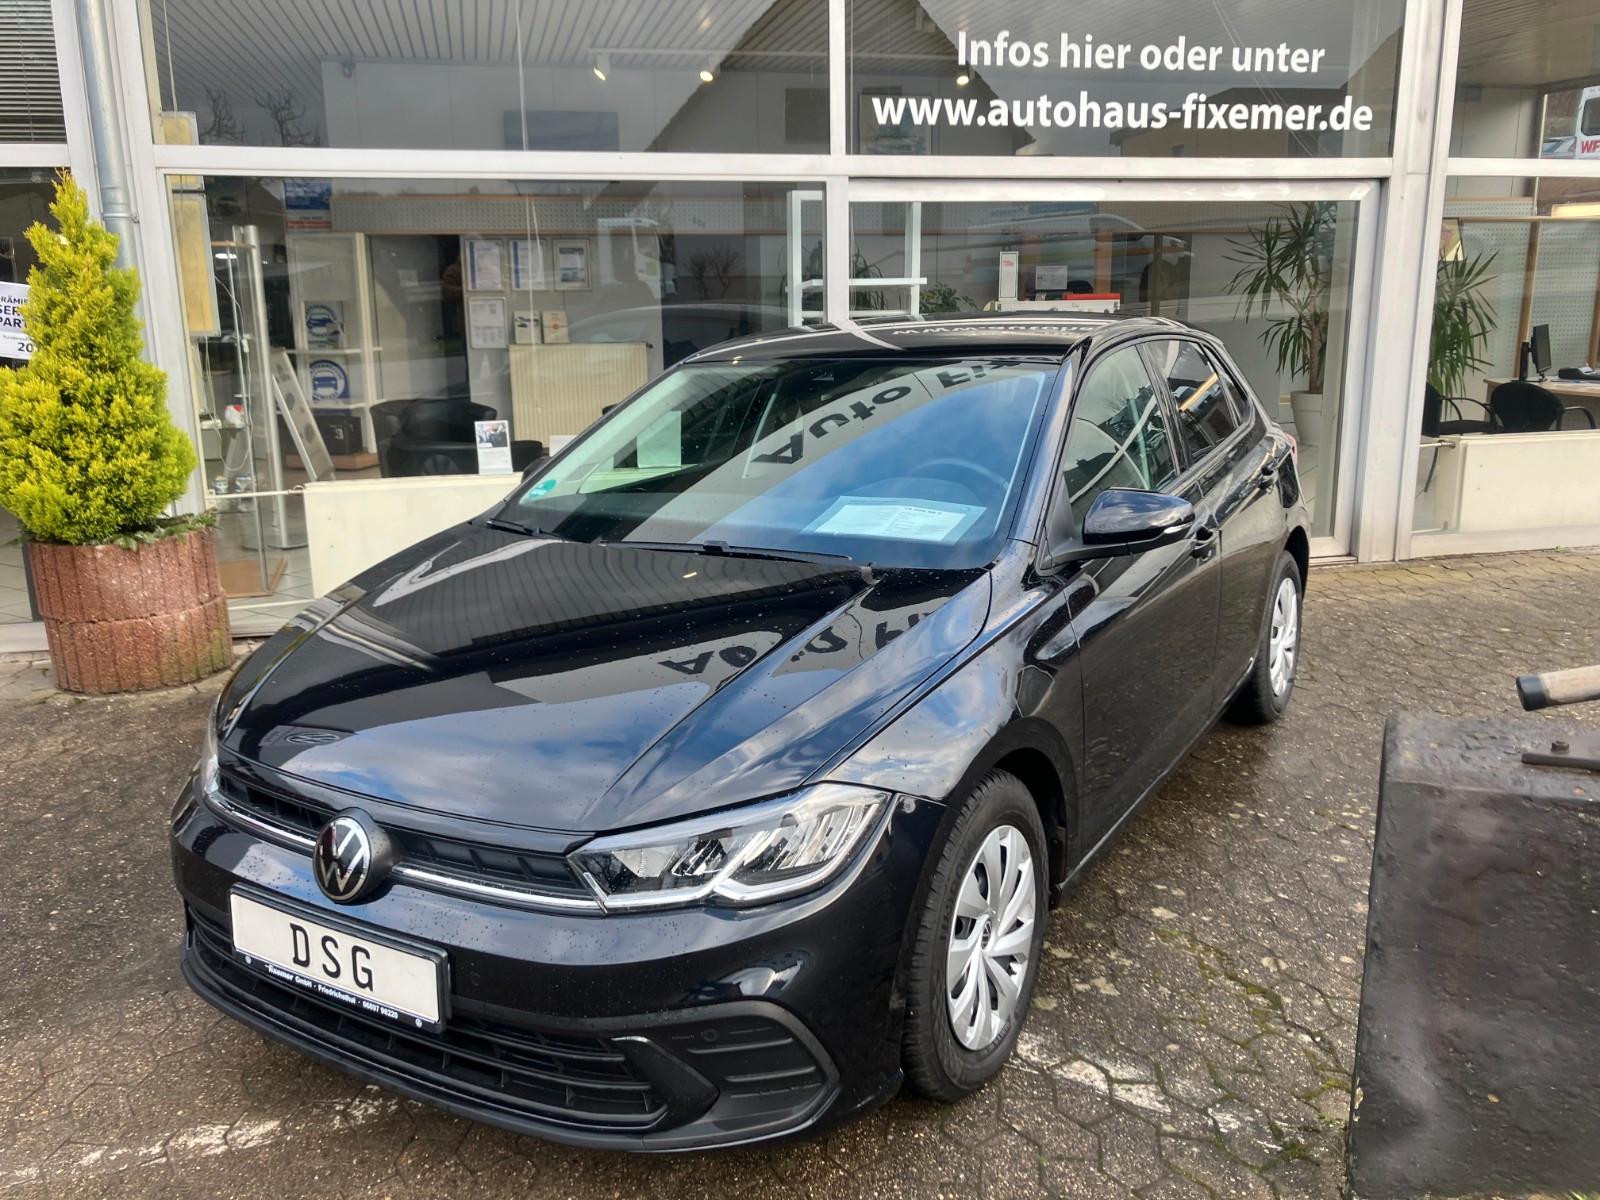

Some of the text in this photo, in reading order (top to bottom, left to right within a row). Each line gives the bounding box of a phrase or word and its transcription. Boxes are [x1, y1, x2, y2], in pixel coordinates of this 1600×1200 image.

[958, 30, 1326, 73] Infos hier oder unter
[871, 91, 1373, 131] www.autohaus-fixemer.de
[295, 975, 312, 988] GmbH
